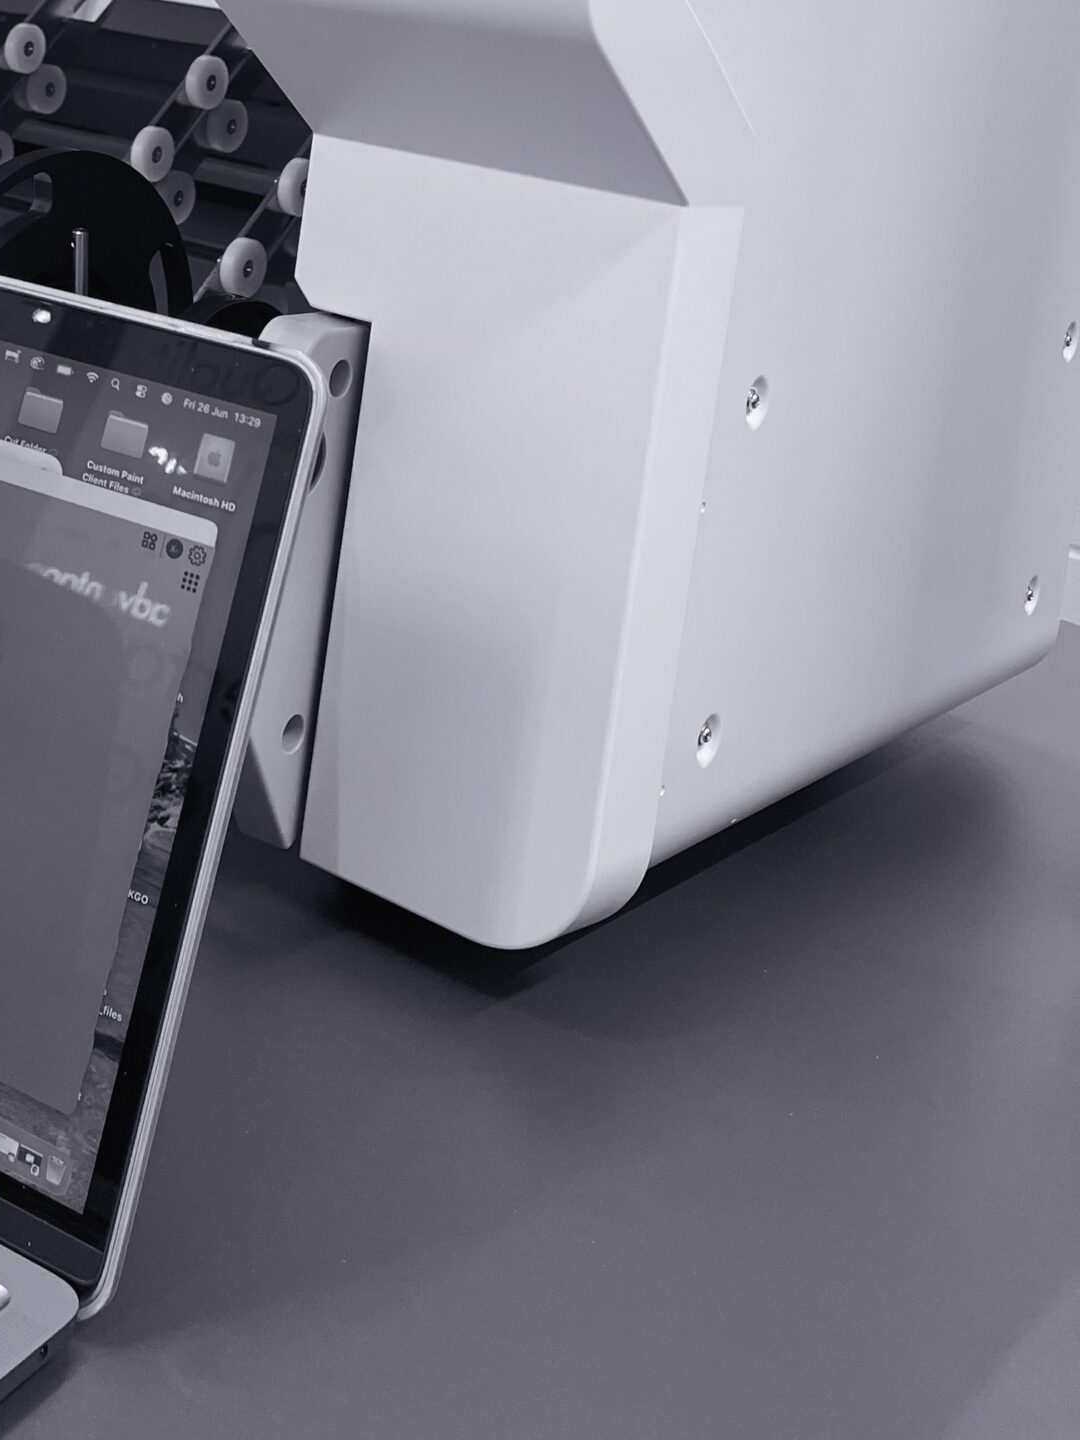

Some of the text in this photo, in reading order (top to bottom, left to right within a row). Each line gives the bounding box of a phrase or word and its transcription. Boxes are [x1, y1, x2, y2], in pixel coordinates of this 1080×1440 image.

[183, 398, 261, 428] Fri 26 Jun 13:29
[4, 435, 47, 453] Cut Folder
[82, 472, 129, 494] Client Files
[87, 460, 144, 484] Custom Paint
[172, 486, 236, 512] Macintosh HD
